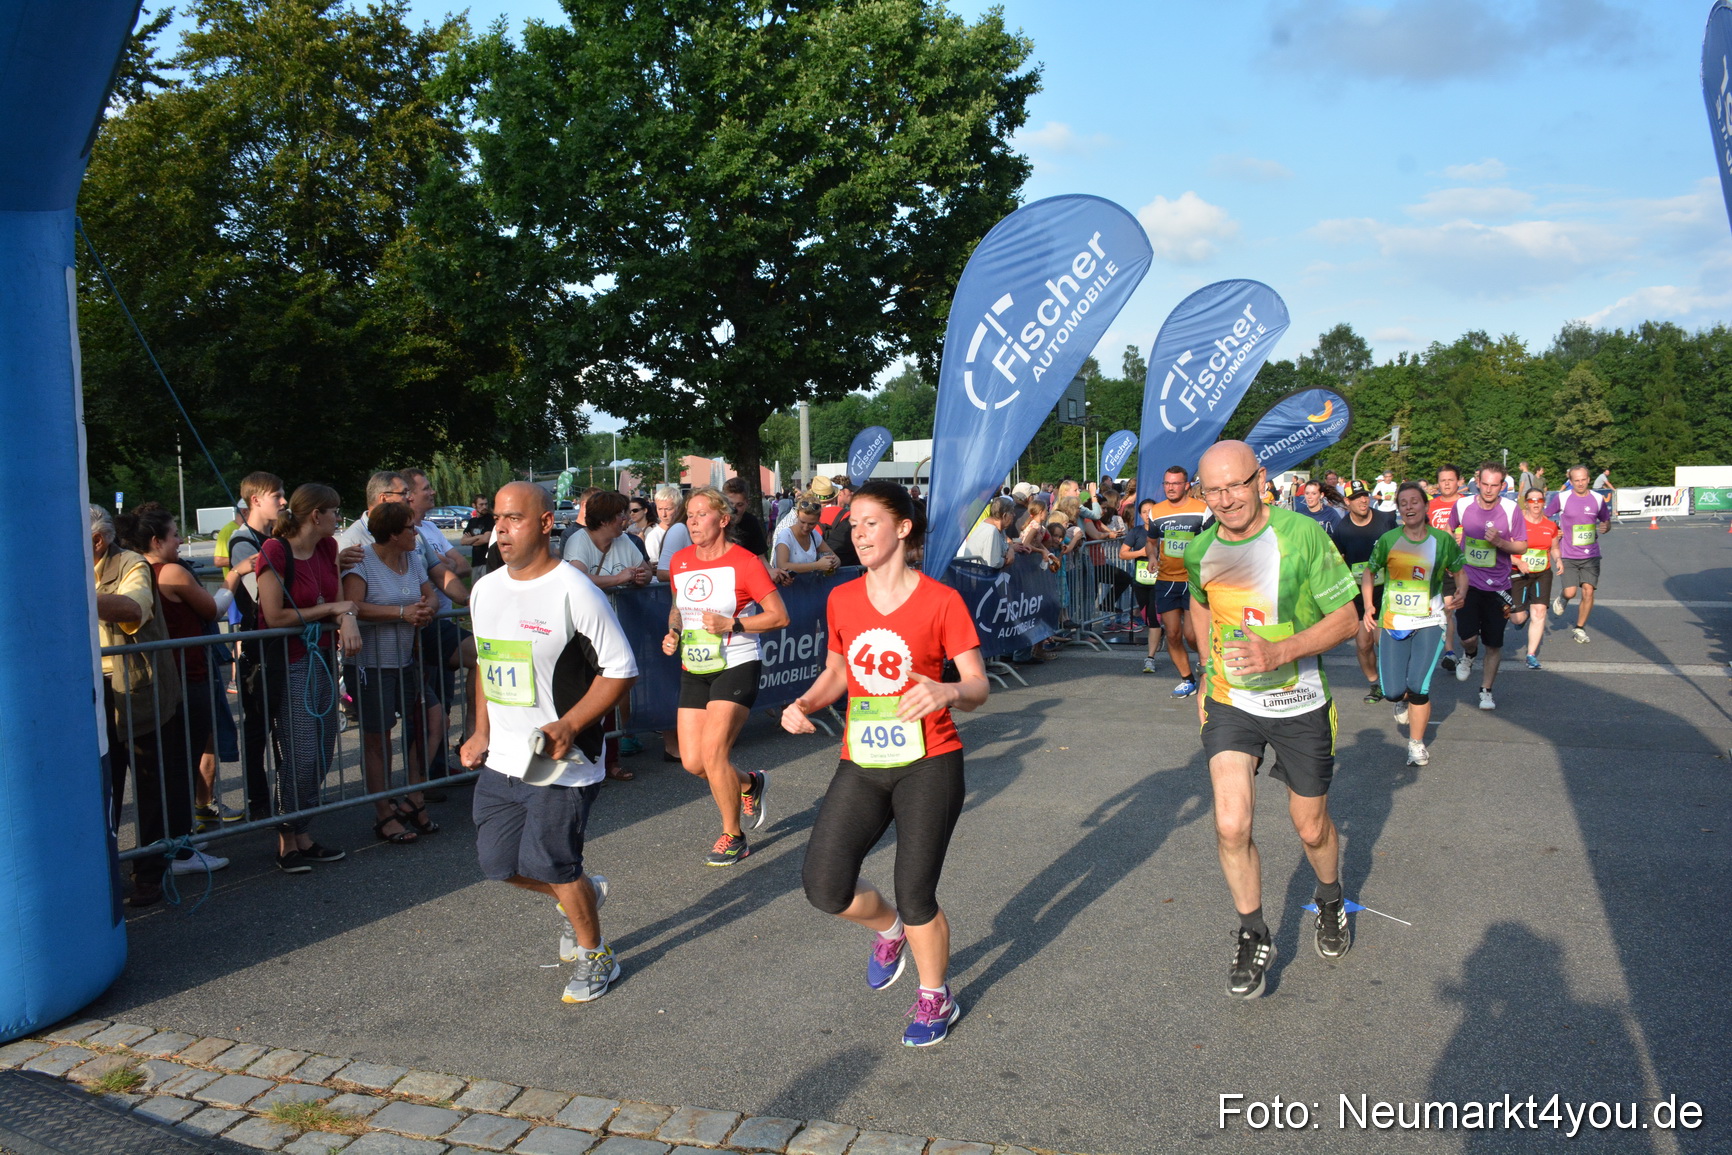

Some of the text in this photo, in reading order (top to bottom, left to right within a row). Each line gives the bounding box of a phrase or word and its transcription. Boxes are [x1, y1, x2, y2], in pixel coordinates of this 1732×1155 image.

[992, 231, 1106, 384] Fischer
[1032, 261, 1119, 383] AUTOMOBILE
[1179, 303, 1257, 414] Fischer
[1207, 323, 1266, 411] AUTOMOBILE
[1287, 440, 1308, 454] Druck
[1321, 418, 1345, 436] Medien
[857, 433, 883, 470] Fischer
[1110, 436, 1130, 466] Fischer
[1578, 532, 1593, 540] 459
[1469, 549, 1489, 560] 467
[1524, 557, 1546, 566] 1054
[1395, 593, 1421, 606] 987
[687, 648, 713, 662] 532
[761, 629, 825, 667] cher
[853, 643, 903, 681] 48
[487, 665, 516, 688] 411
[759, 664, 818, 690] OMOBILE
[1263, 691, 1317, 708] Lammsbräu
[861, 725, 906, 748] 496
